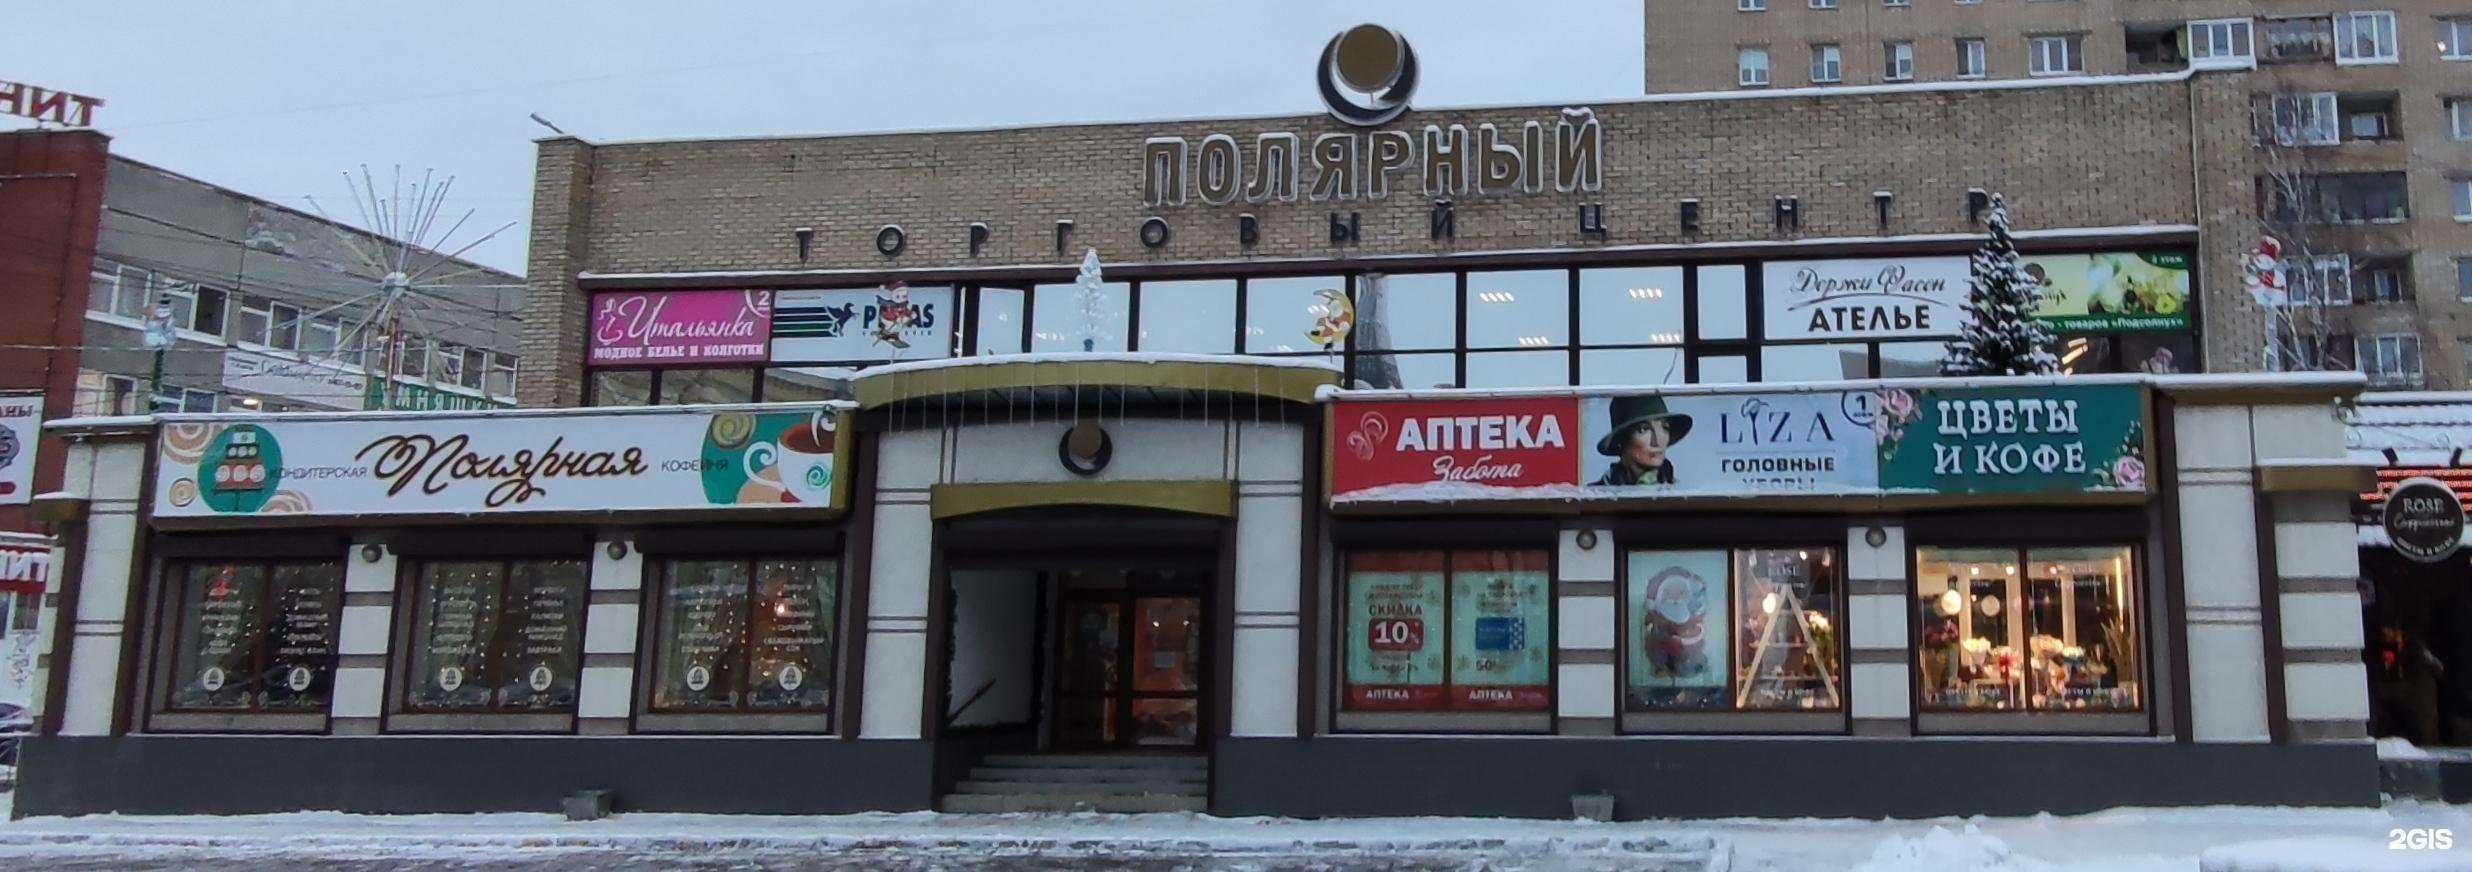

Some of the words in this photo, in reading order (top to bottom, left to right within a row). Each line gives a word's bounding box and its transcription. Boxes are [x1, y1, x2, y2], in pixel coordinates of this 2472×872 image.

[1143, 107, 1602, 207] ПОЛЯРНЫЙ
[1579, 187, 1990, 236] ЦЕНТР
[796, 199, 1454, 263] ТОРГОВЫЙ
[757, 291, 770, 306] 2
[863, 303, 934, 328] PAS
[618, 296, 754, 345] Итальянка
[1808, 305, 1930, 332] АТЕЛЬЕ
[594, 347, 642, 360] МОДНОЕ
[647, 346, 685, 358] БЕЛЬЕ
[690, 345, 699, 357] И
[703, 344, 764, 356] КОЛГОТКИ
[1856, 395, 1866, 411] 1
[1936, 400, 2079, 440] ЦВЕТЫ
[1396, 413, 1565, 451] АПТЕКА
[1719, 407, 1835, 446] LIZA
[355, 433, 649, 508] Полярная
[1432, 454, 1524, 481] Забота
[1720, 456, 1835, 473] ГОЛОВНЫЕ
[1934, 442, 1963, 475] И
[1975, 441, 2087, 474] КОФЕ
[1365, 689, 1410, 700] АПТЕКА
